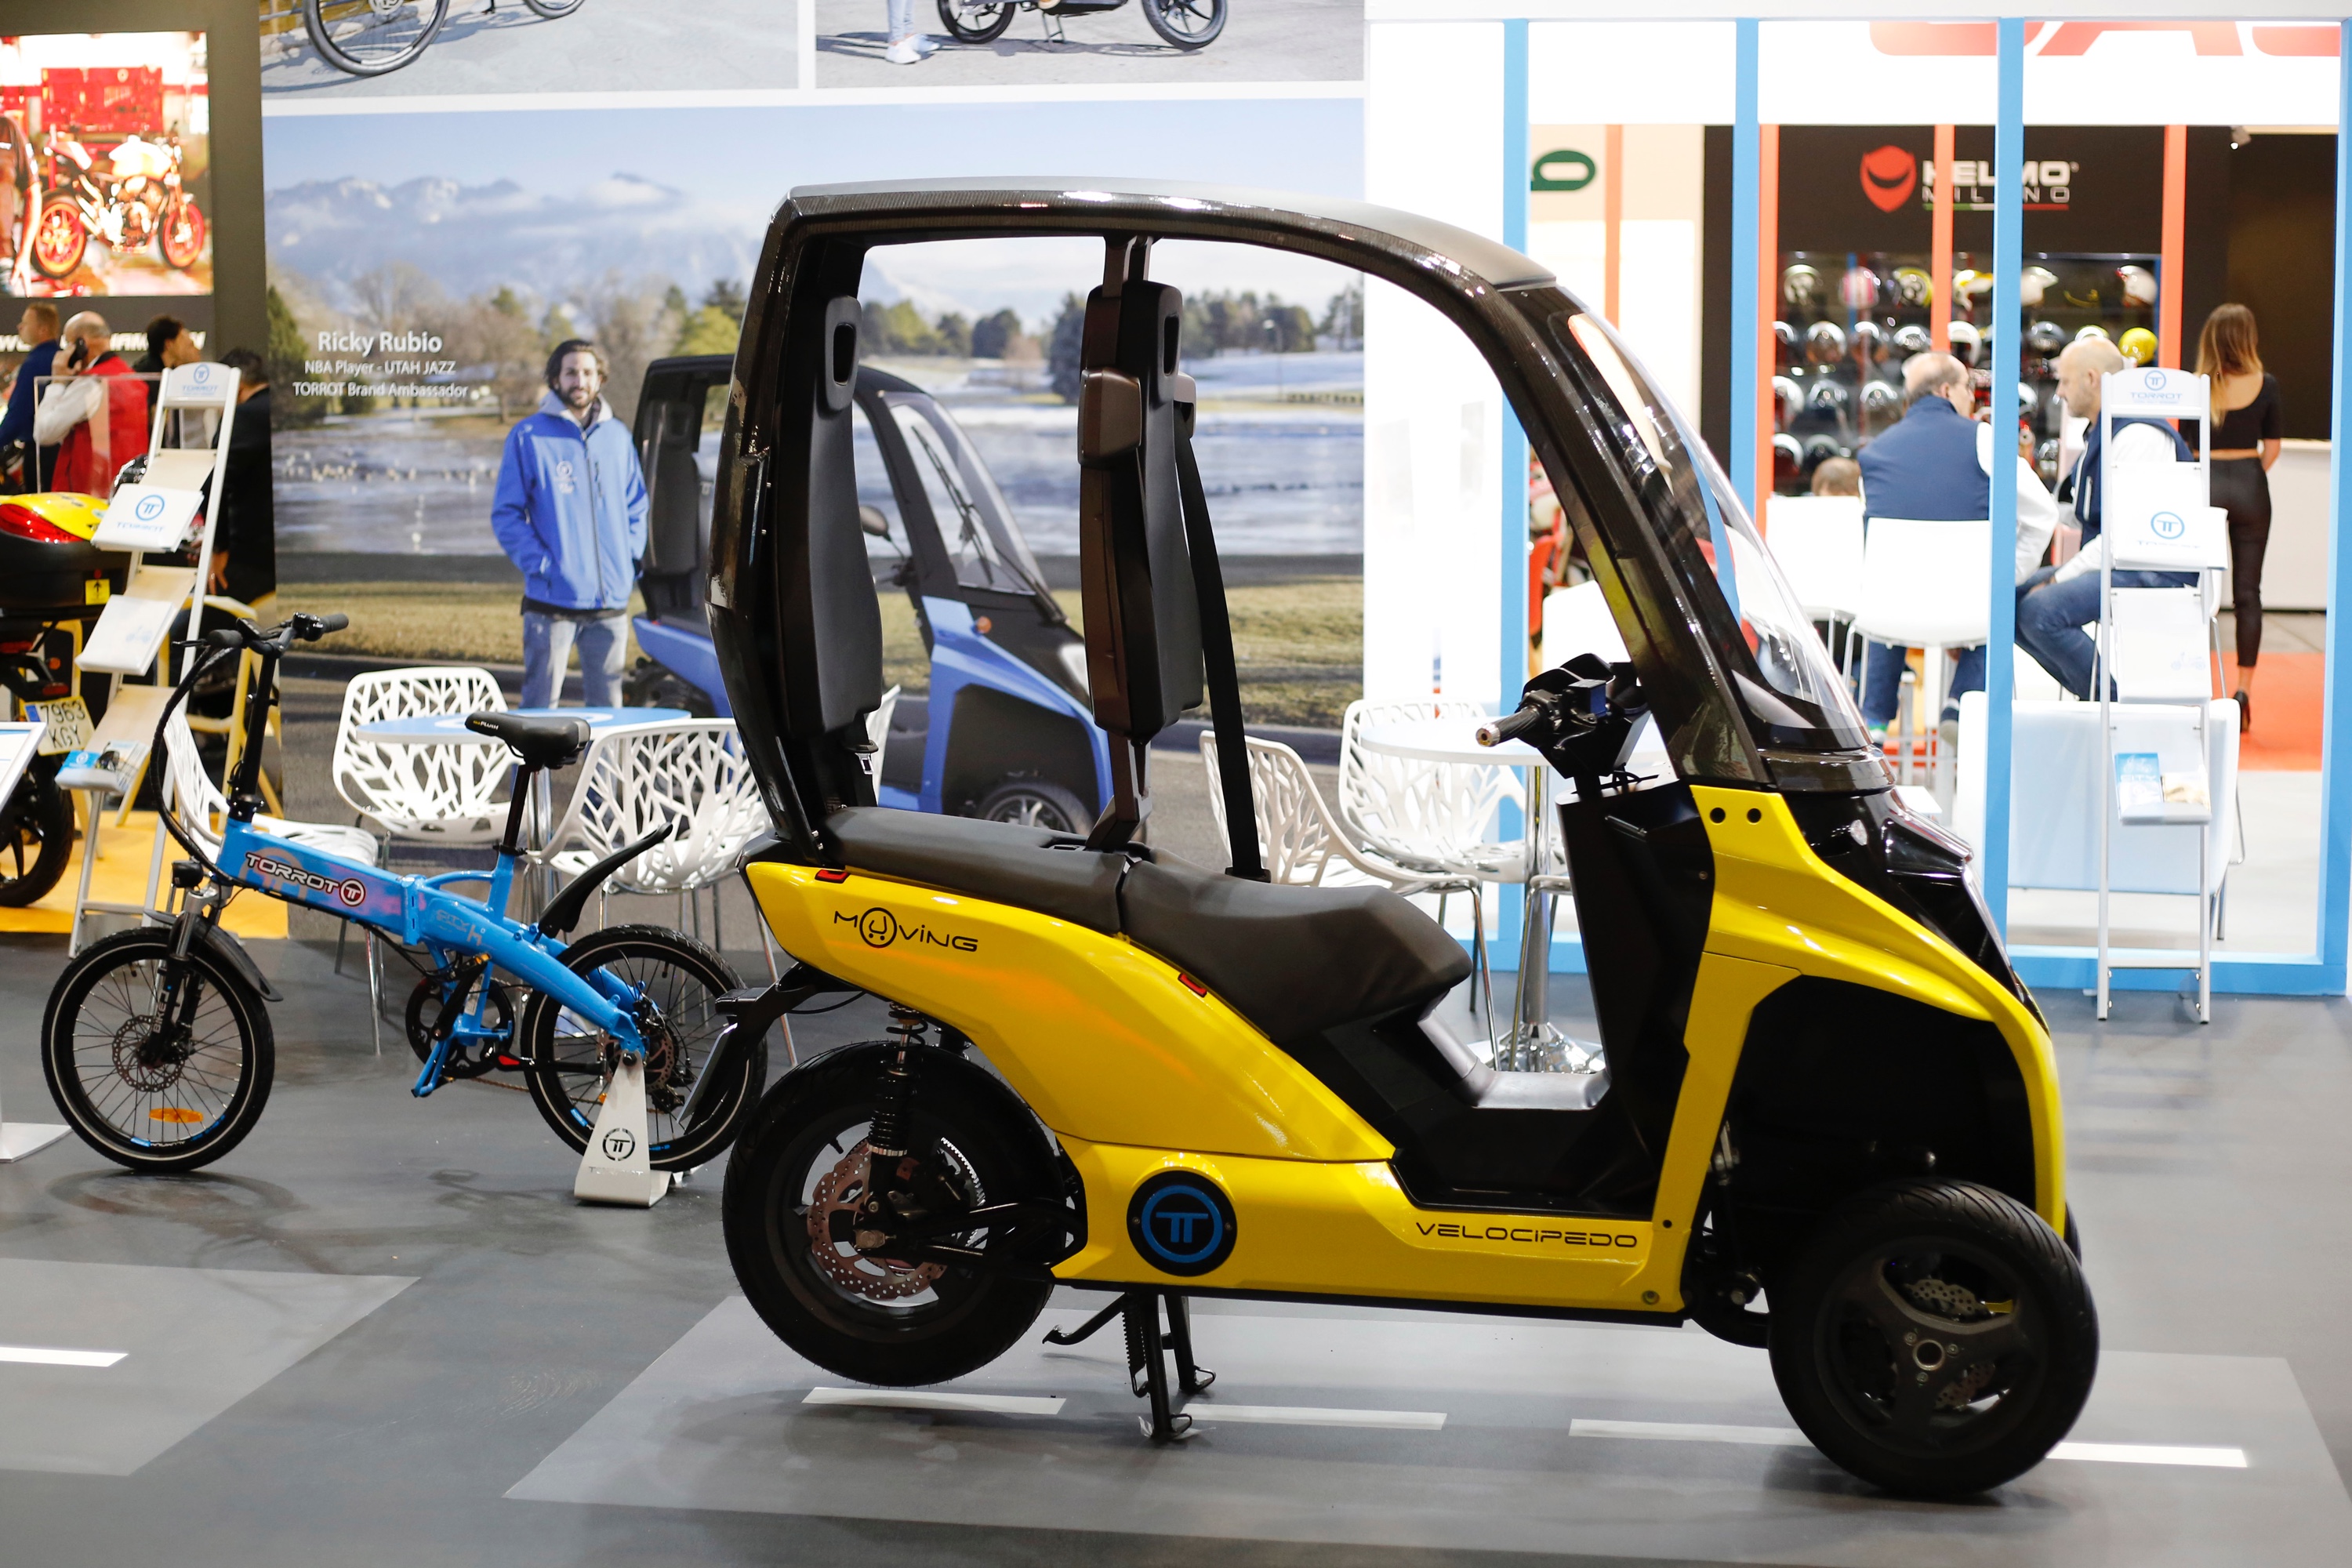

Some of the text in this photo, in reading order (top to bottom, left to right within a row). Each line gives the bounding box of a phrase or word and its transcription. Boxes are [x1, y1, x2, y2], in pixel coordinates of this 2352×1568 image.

[1922, 187, 2071, 203] MILNO
[318, 331, 443, 358] Ricky Rubio
[305, 360, 332, 375] NBA
[336, 360, 375, 377] Player
[384, 361, 421, 375] UTAH
[423, 361, 456, 375] JAZZ
[292, 382, 469, 397] TORROT Brand Ambassador
[40, 702, 85, 724] 7963
[48, 724, 82, 749] KGY
[246, 852, 339, 894] TORROT
